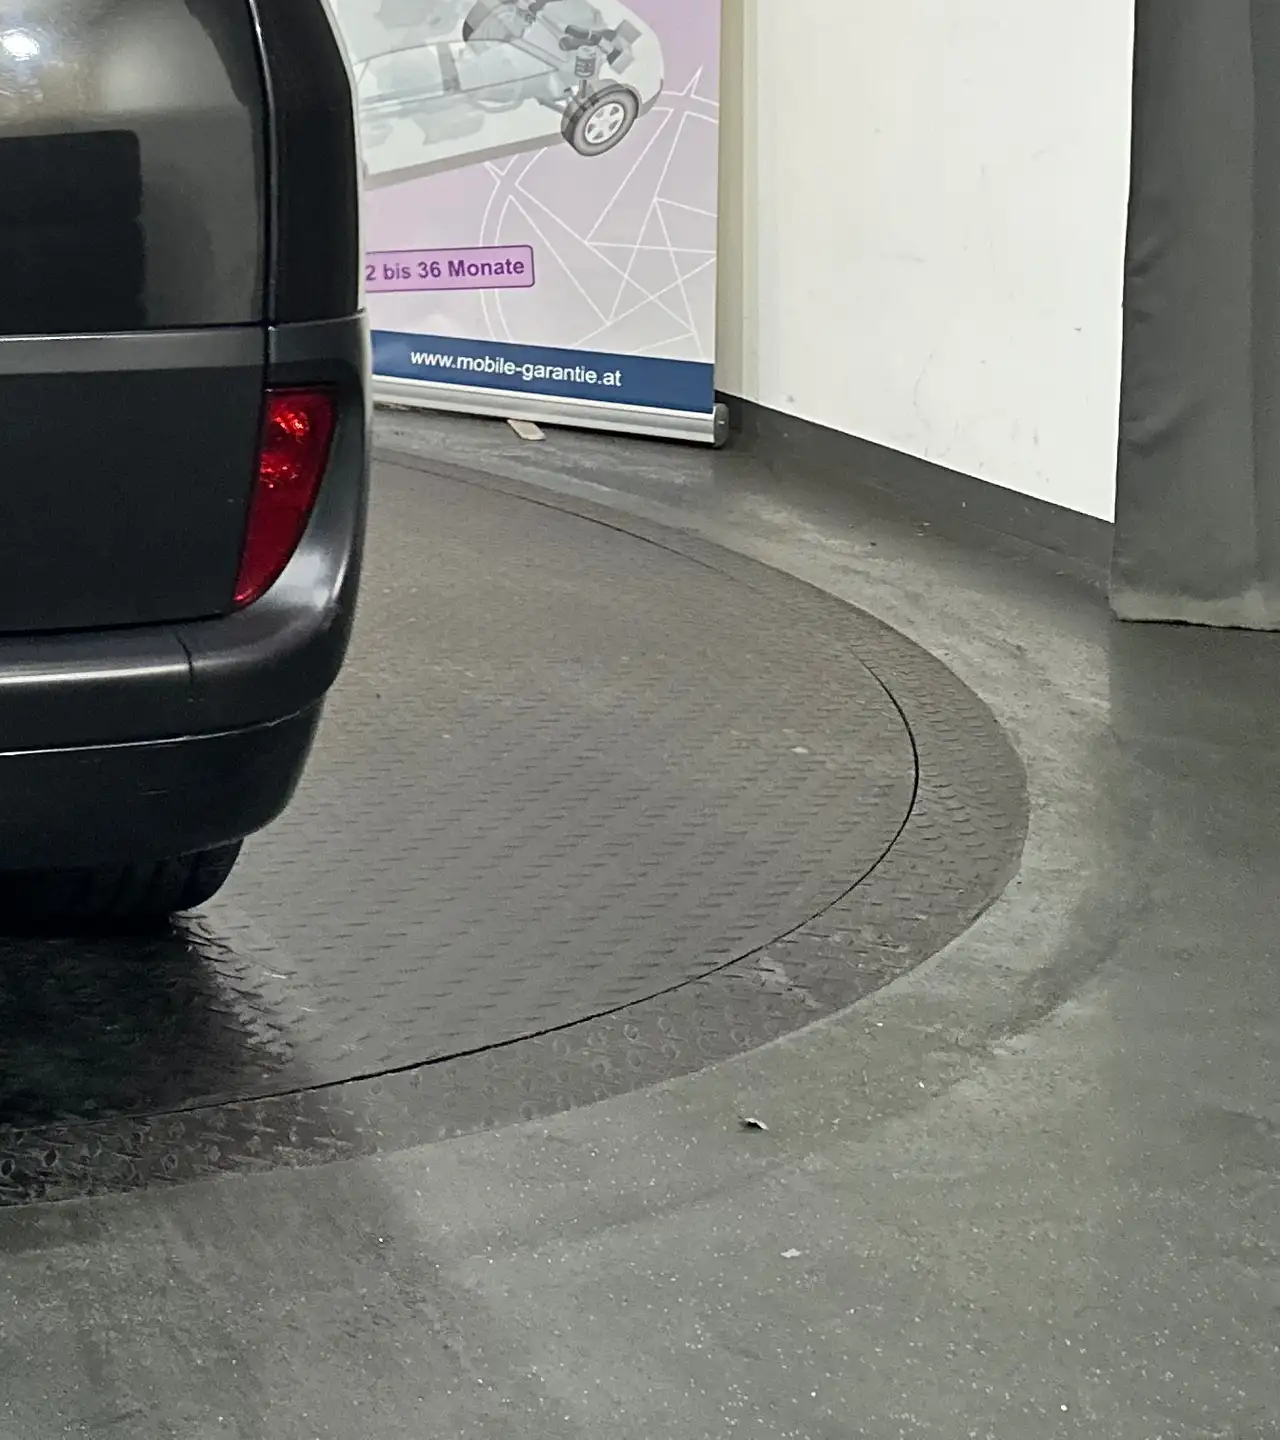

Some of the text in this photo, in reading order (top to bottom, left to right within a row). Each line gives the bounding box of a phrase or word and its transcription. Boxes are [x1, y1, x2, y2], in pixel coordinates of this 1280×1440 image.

[383, 262, 412, 280] bis
[417, 260, 442, 279] 36
[448, 258, 525, 278] Monate
[410, 350, 622, 387] www.mobile-garantie.at
